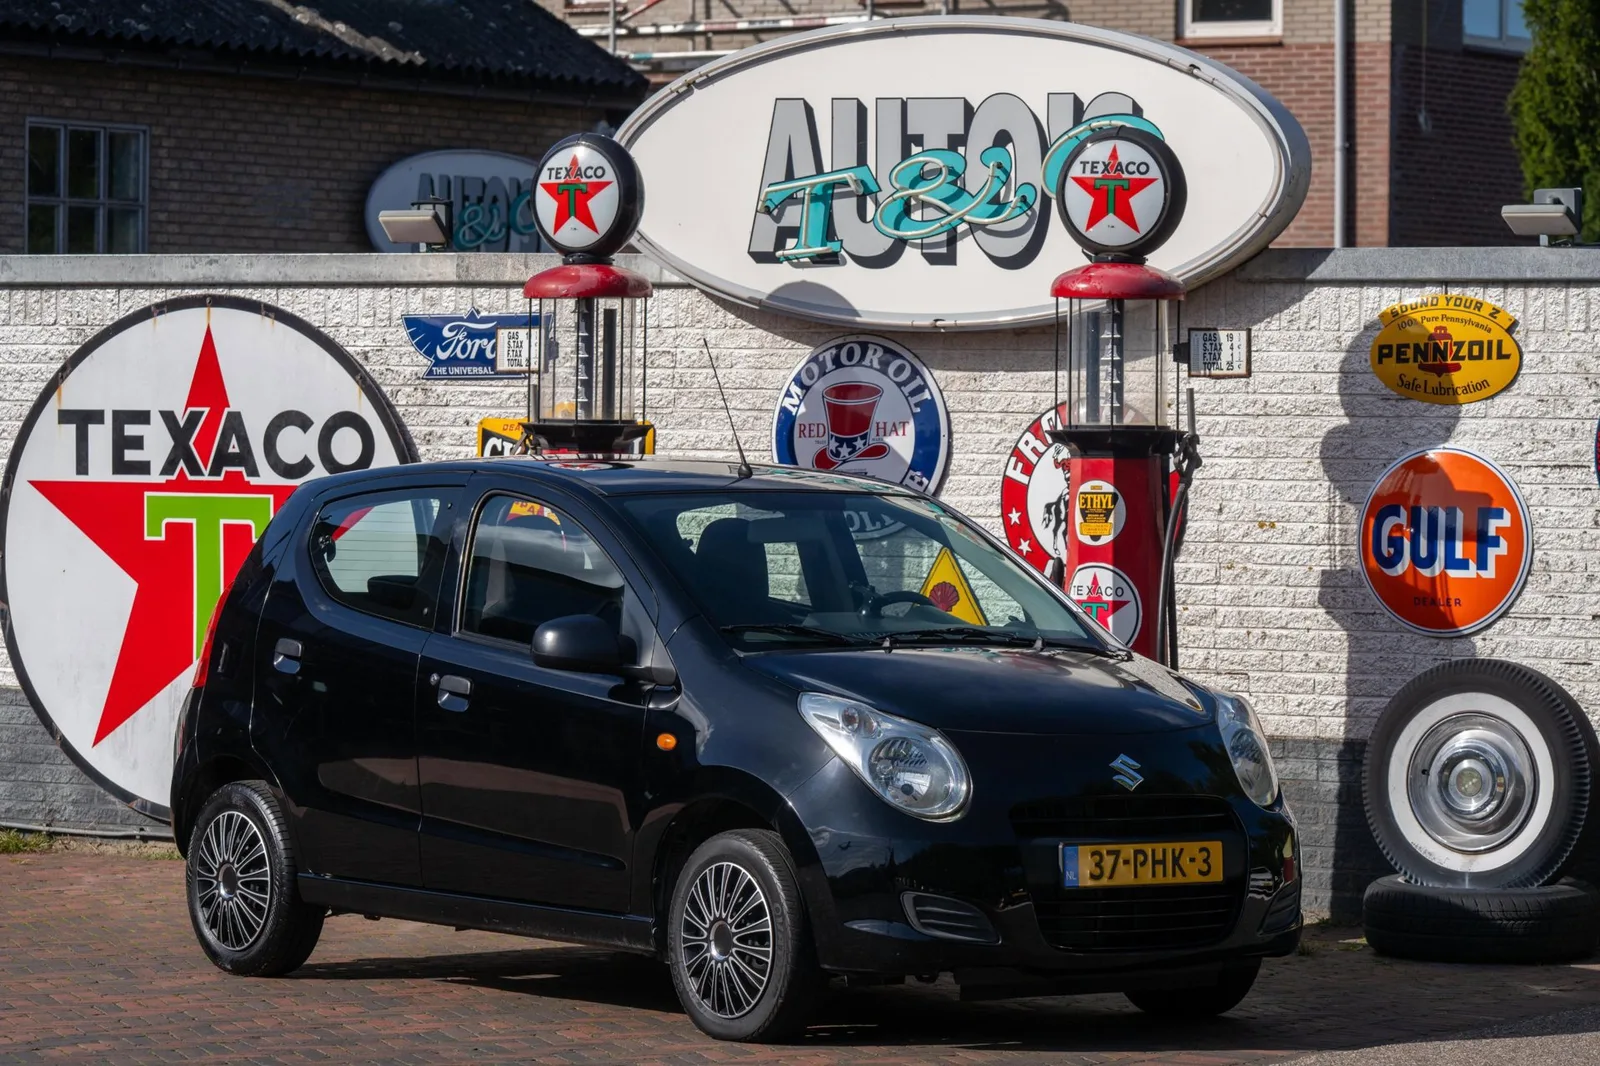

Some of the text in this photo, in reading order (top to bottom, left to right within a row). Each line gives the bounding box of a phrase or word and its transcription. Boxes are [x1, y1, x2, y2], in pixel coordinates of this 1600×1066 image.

[547, 166, 605, 180] TEXACO
[1080, 161, 1150, 175] TEXACO
[747, 92, 1143, 269] AUTO'
[1390, 296, 1501, 319] SOUND YOUR Z
[1421, 315, 1440, 324] Pure
[1441, 314, 1492, 334] Pennsylvania
[507, 331, 519, 340] GAS
[1203, 333, 1218, 342] GAS
[1226, 333, 1234, 342] 19
[507, 340, 523, 349] S.TAX
[1203, 343, 1223, 351] S.TAX
[1229, 343, 1234, 351] 4
[1377, 339, 1512, 364] PENNZOIL
[507, 349, 522, 358] F.TAX
[1203, 352, 1222, 361] F.TAX
[507, 358, 523, 367] TOTAL
[1203, 362, 1224, 371] TOTAL
[1226, 362, 1234, 371] 25
[432, 367, 494, 375] THE UNIVERSAL
[781, 342, 932, 416] MOTOR OIL
[1397, 373, 1490, 397] Safe Lubrication
[798, 421, 909, 438] RED HAT
[57, 408, 376, 481] TEXACO
[1080, 494, 1114, 509] ETHYL
[1372, 503, 1511, 578] GULF
[1073, 585, 1125, 598] TEXACO
[1413, 597, 1462, 607] DEALER
[1065, 847, 1212, 881] NL 37-PHK-3
